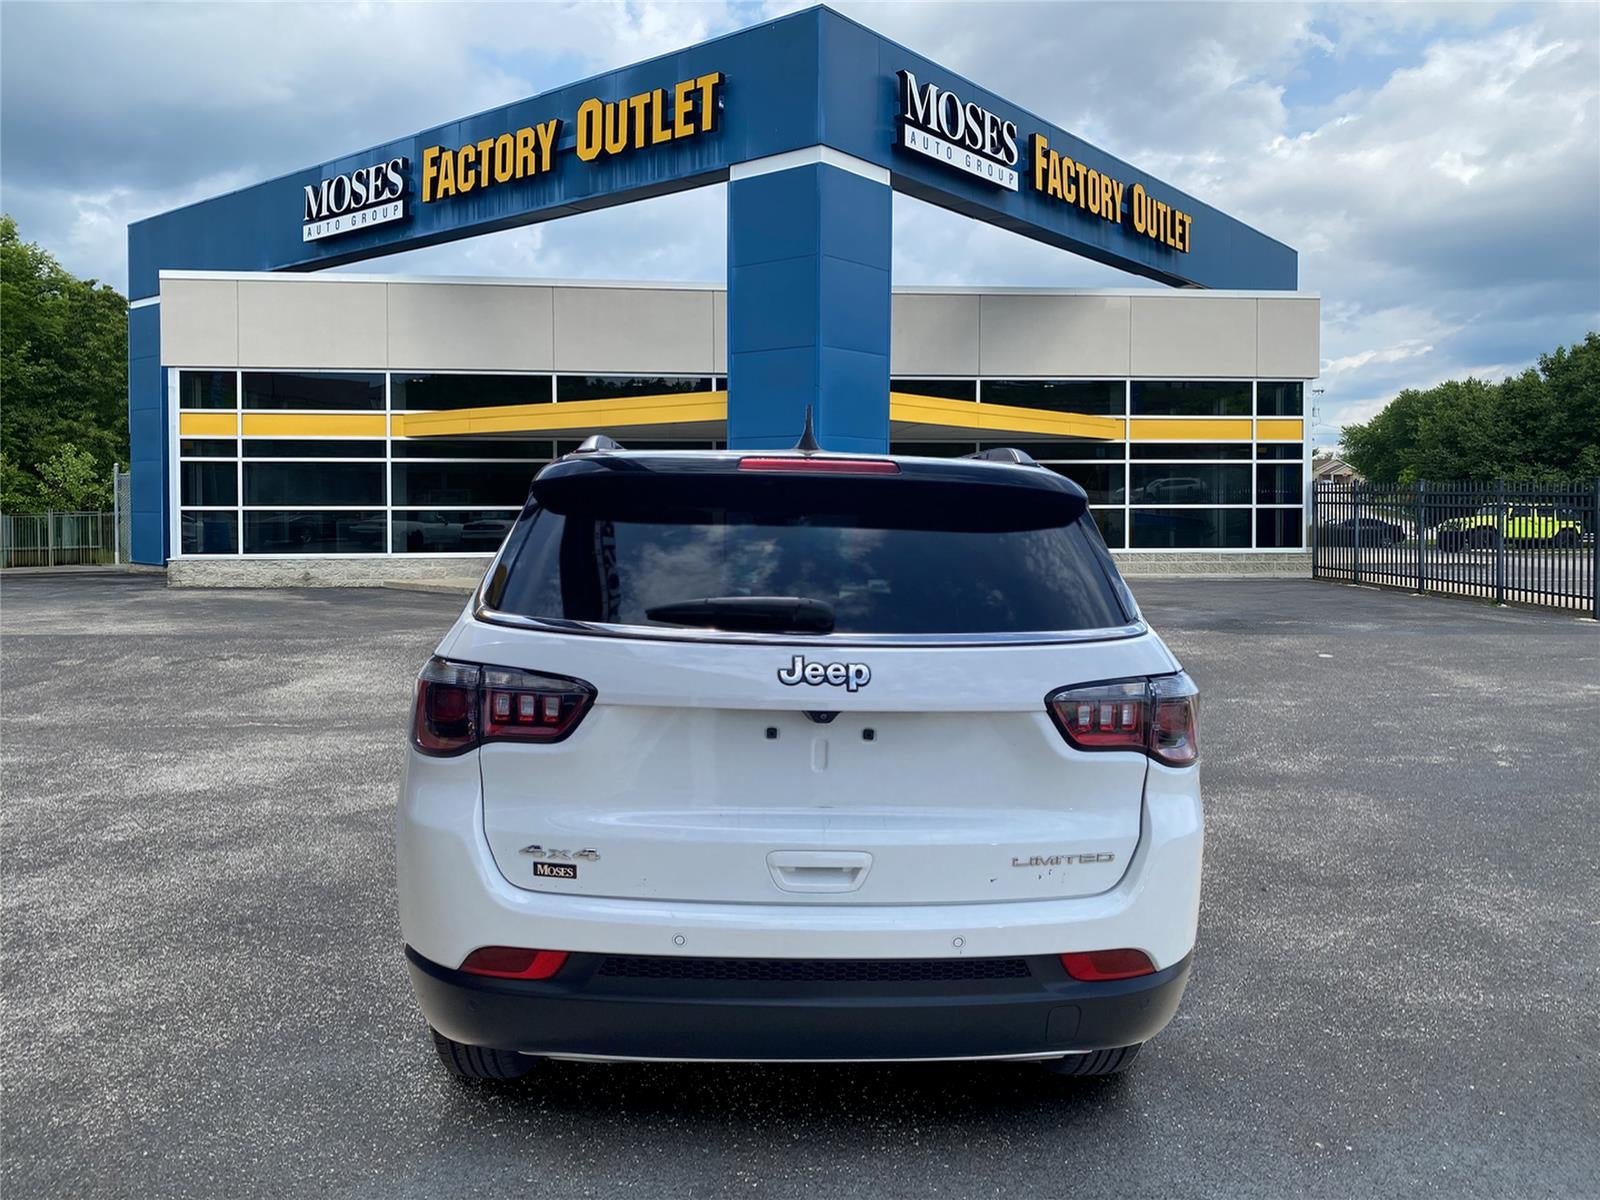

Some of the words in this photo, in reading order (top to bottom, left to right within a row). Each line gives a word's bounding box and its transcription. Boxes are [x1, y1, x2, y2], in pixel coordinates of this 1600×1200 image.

[422, 119, 560, 203] FACTORY
[576, 71, 720, 162] OUTLET
[903, 70, 1019, 166] MOSES
[909, 131, 952, 160] AUTO
[965, 154, 1015, 184] GROUP
[303, 158, 404, 221] MOSES
[1034, 133, 1124, 224] FACTORY
[1131, 183, 1192, 253] OUTLET
[307, 219, 341, 238] AUTO
[351, 204, 399, 226] GROUP
[778, 655, 871, 692] Jeep
[536, 864, 574, 877] MOSES
[1011, 852, 1115, 867] LIMITED
